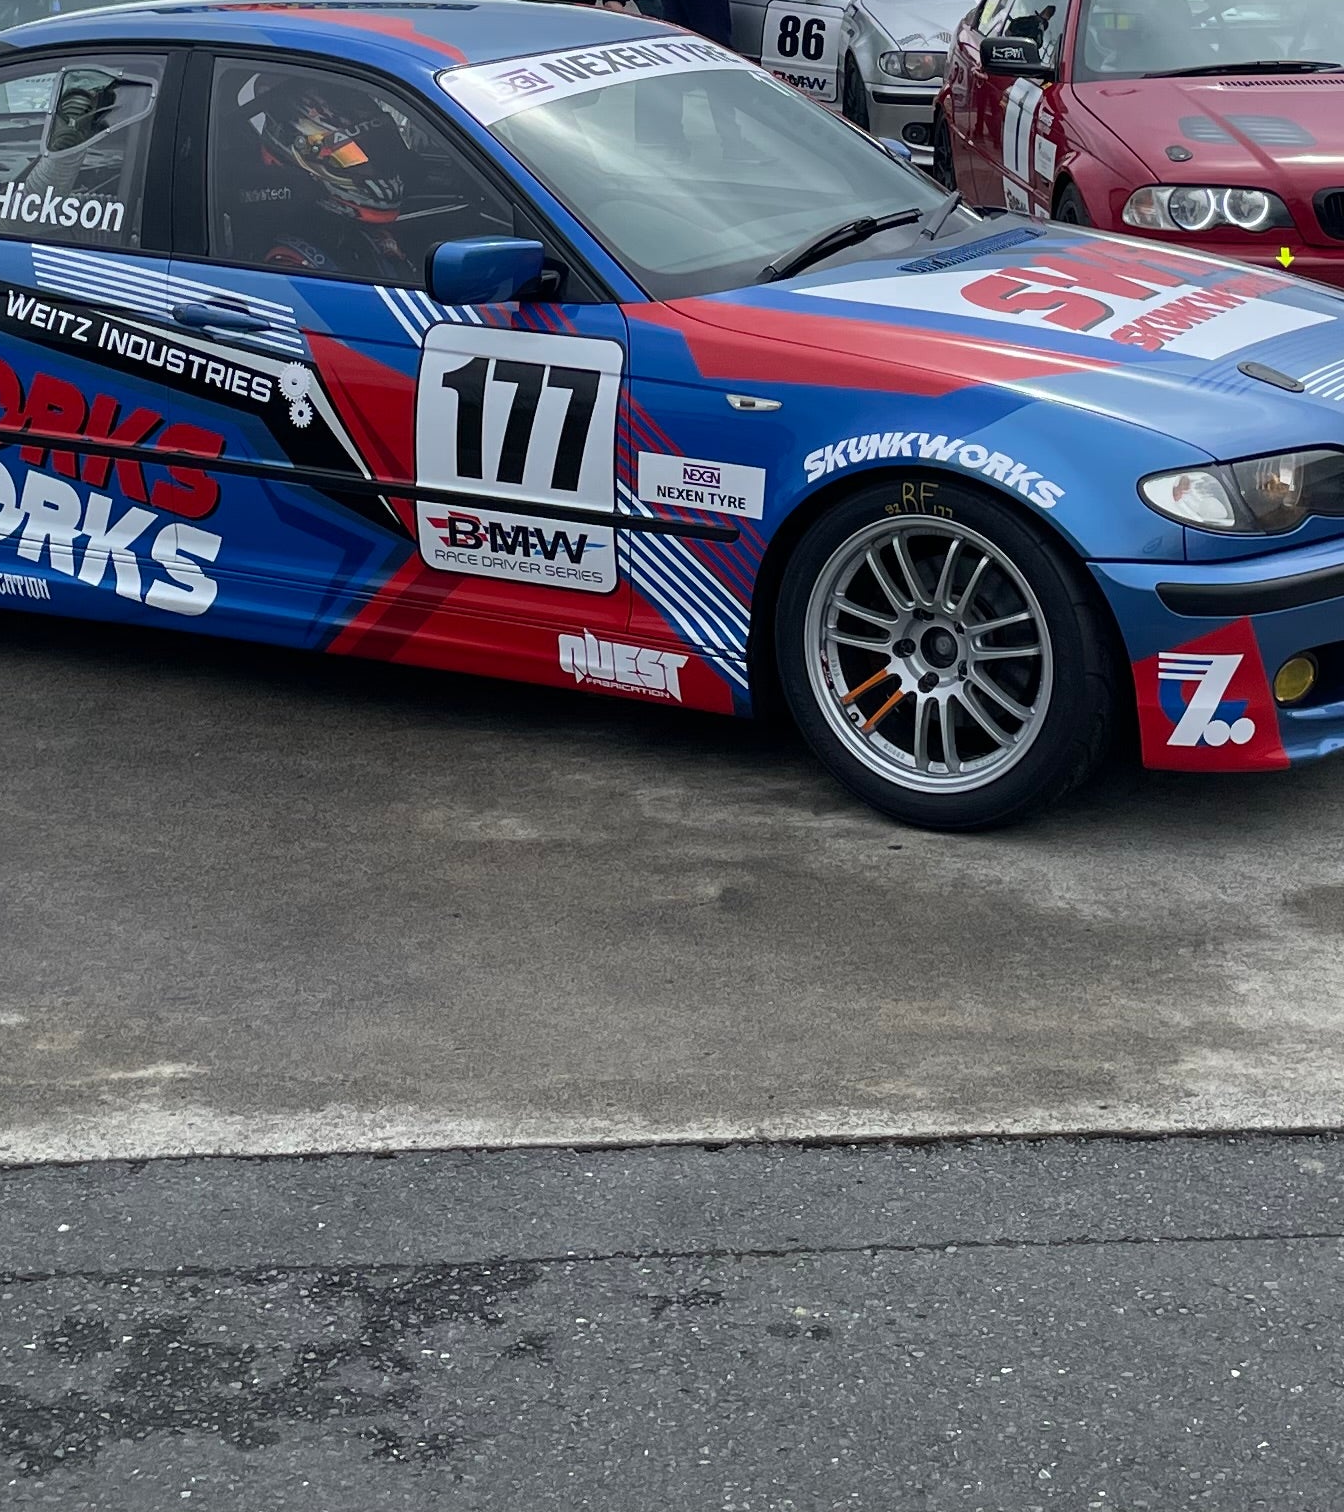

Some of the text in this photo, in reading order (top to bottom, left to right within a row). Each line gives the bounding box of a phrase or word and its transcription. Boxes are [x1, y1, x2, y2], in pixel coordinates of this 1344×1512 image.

[777, 15, 826, 61] 86
[540, 44, 672, 83] NEXEN
[6, 290, 273, 403] WEITZ INDUSTRIES
[442, 357, 602, 492] 177
[683, 464, 720, 487] NEXEN
[803, 432, 1066, 509] SKUNKWORKS
[657, 485, 746, 510] NEXEN TYRE
[902, 482, 939, 513] RF
[447, 516, 588, 564] BMW
[435, 549, 603, 584] RACE DRIVER SERIES
[558, 627, 689, 703] QUEST
[586, 678, 670, 699] FABRICATION
